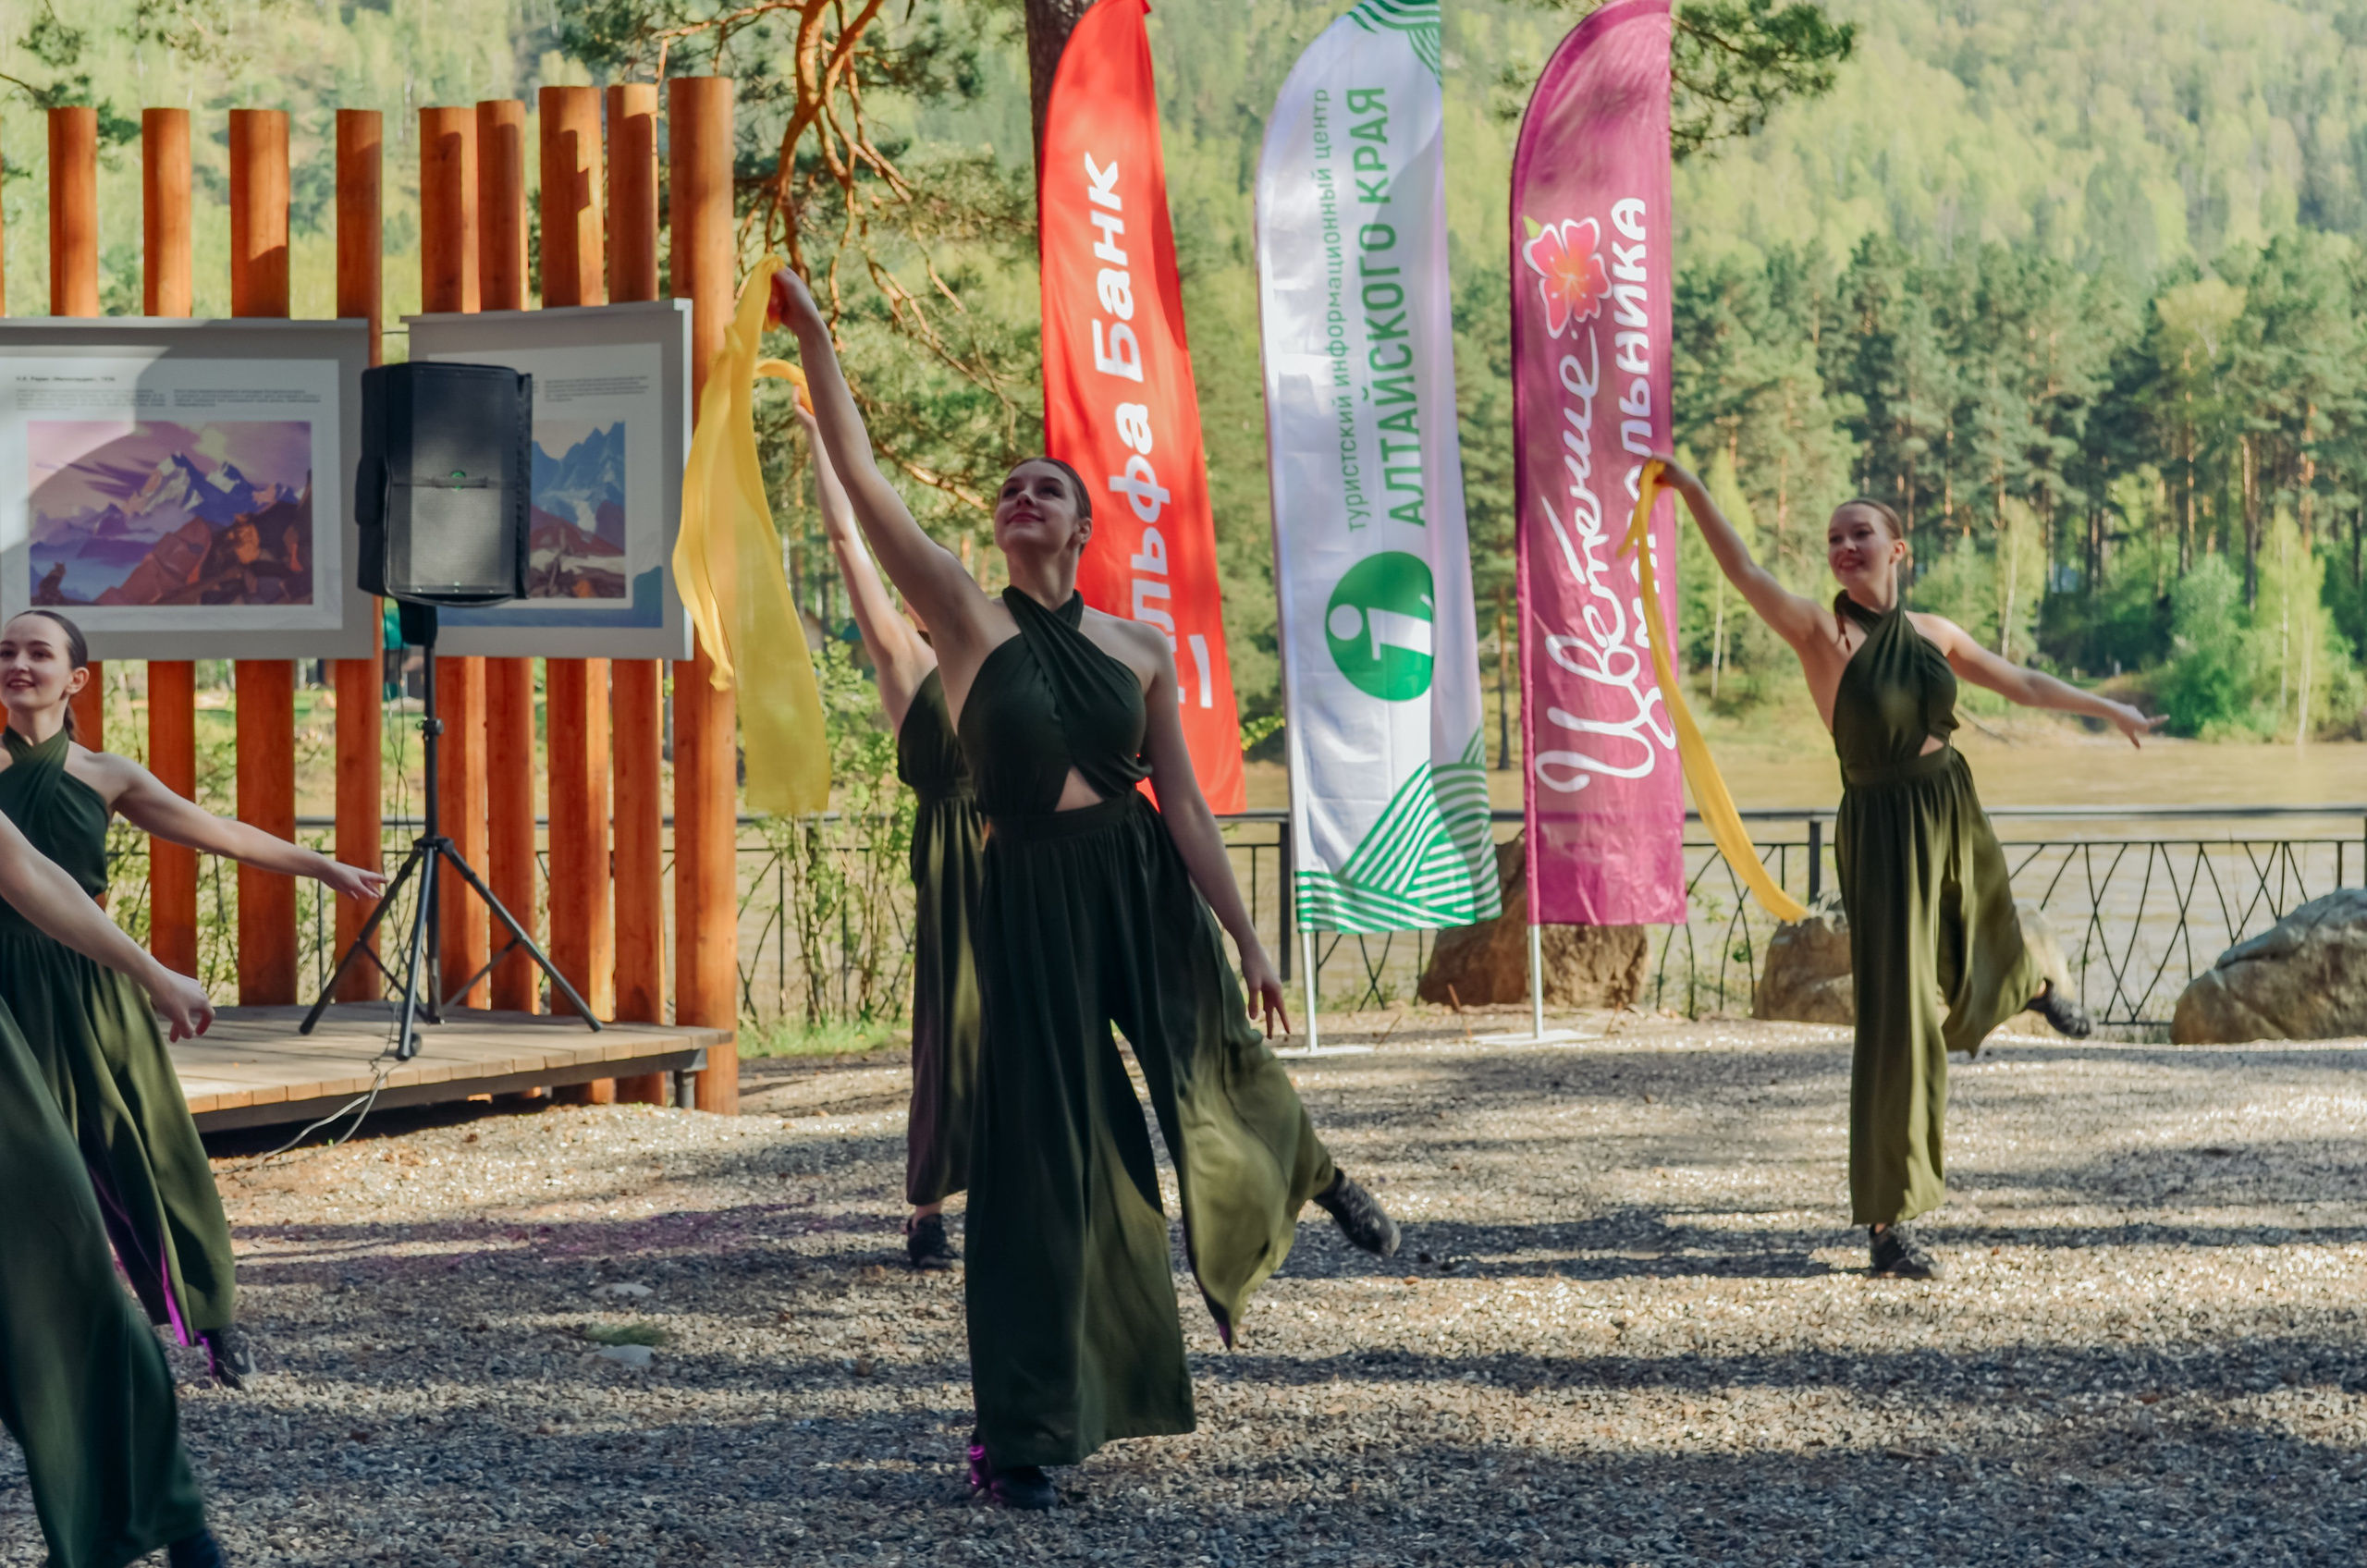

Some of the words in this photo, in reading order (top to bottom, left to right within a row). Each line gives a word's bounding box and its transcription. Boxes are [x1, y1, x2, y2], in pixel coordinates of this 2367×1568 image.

[1314, 88, 1331, 159] центр
[1346, 87, 1392, 204] КРАЯ
[1083, 151, 1144, 383] Банк
[1311, 167, 1352, 386] информационный
[1358, 222, 1425, 527] АЛТАЙСКОГО
[1109, 401, 1186, 705] льфа
[1331, 395, 1370, 532] туристский
[1533, 325, 1675, 792] Цветение
